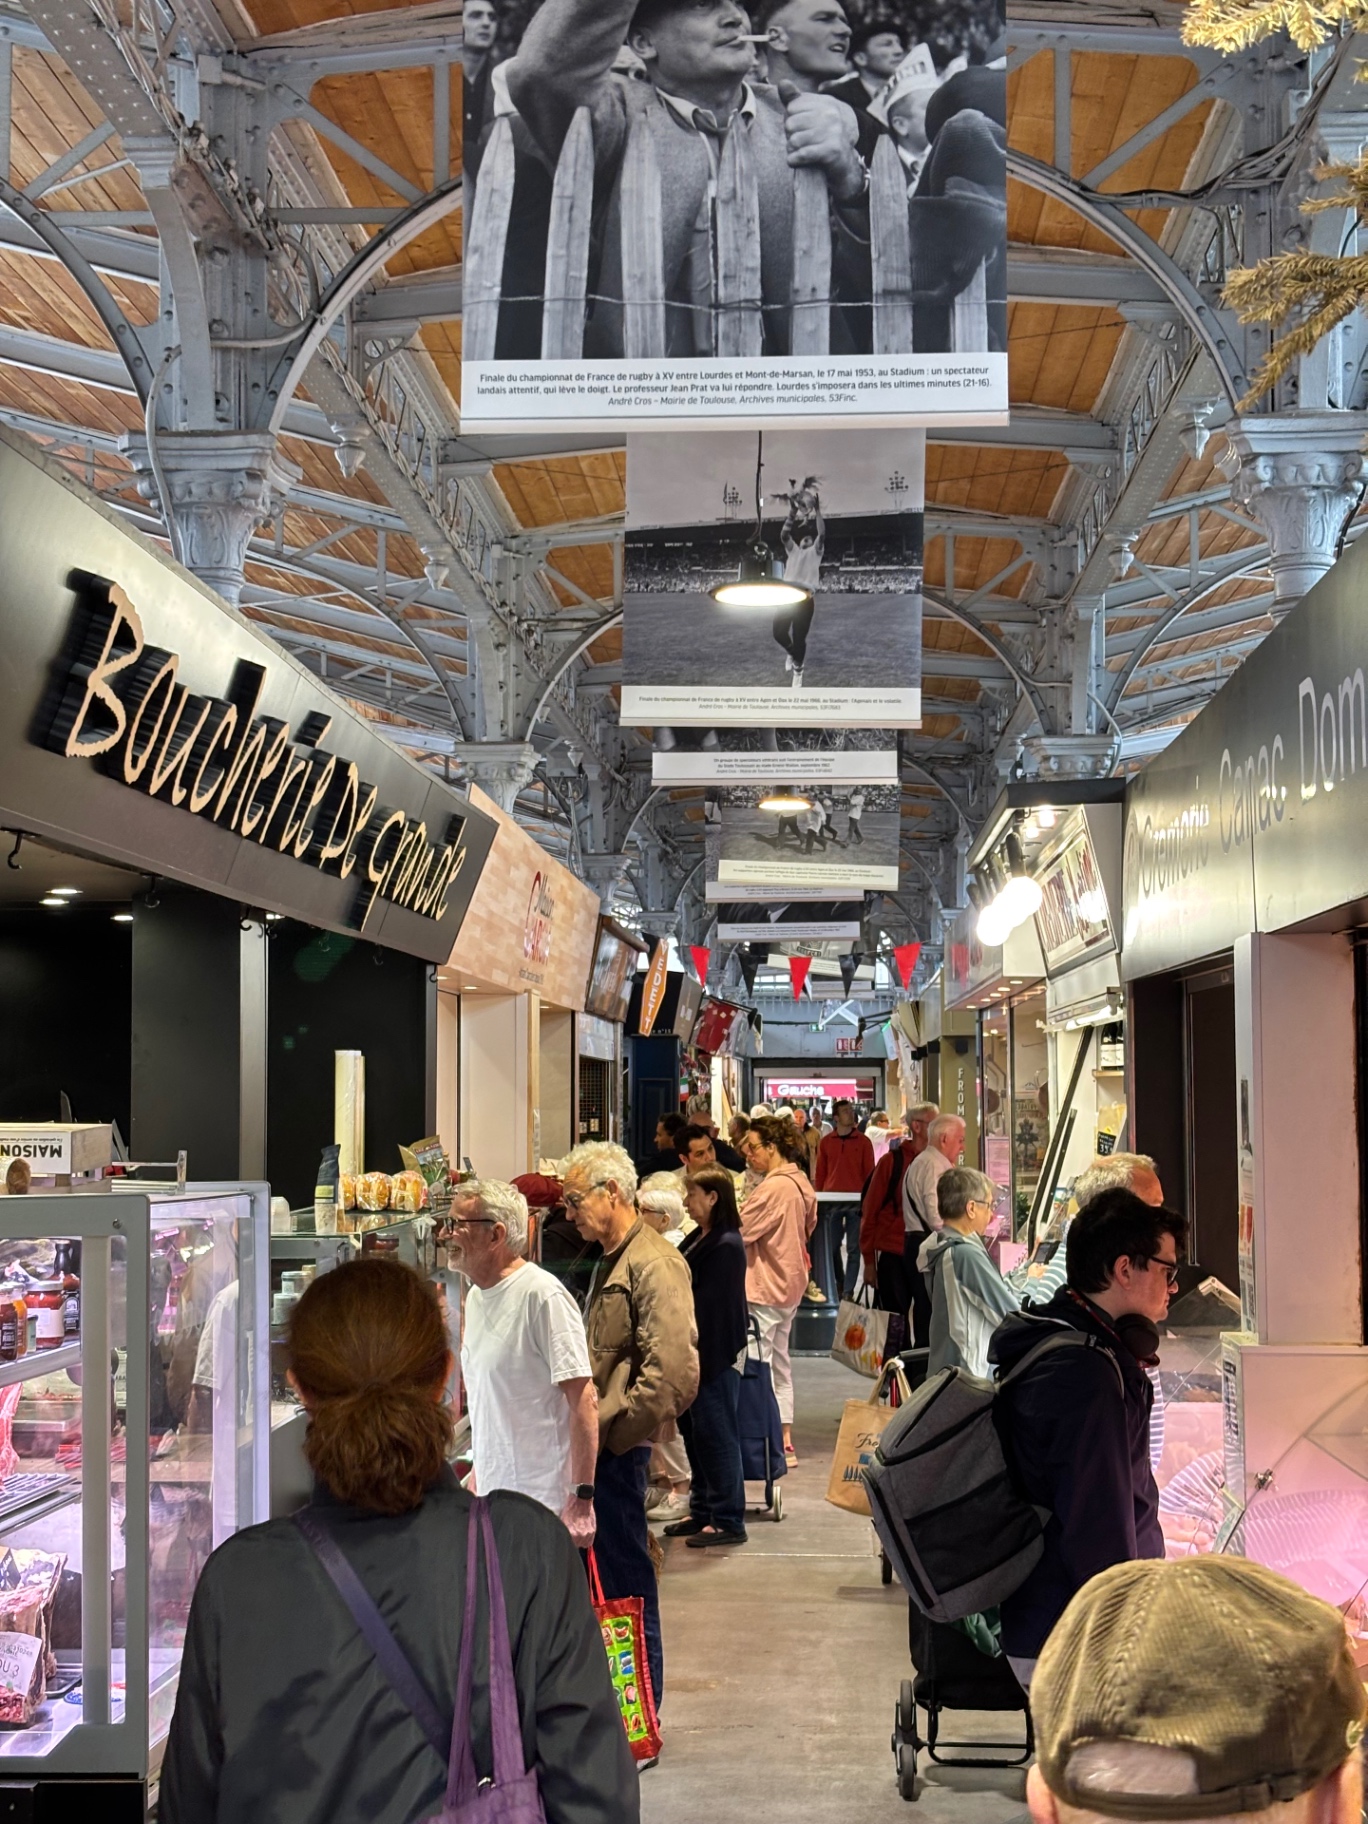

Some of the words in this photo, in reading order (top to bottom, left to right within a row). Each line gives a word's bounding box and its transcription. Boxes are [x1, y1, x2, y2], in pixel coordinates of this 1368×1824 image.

[479, 373, 505, 382] Finale
[506, 373, 517, 382] du
[518, 373, 572, 383] championnat
[574, 373, 585, 381] de
[586, 372, 615, 381] France
[616, 372, 627, 381] de
[628, 372, 653, 381] rugby
[654, 372, 660, 380] à
[662, 371, 674, 380] XV
[675, 372, 698, 380] entre
[699, 370, 733, 379] Lourdes
[734, 371, 743, 379] et
[745, 369, 815, 379] Mont-de-Marsan,
[817, 369, 825, 377] le
[826, 368, 835, 377] 17
[836, 368, 852, 377] mai
[854, 368, 876, 377] 1953,
[890, 367, 924, 376] Stadium
[944, 366, 988, 377] spectateur
[477, 386, 506, 394] landais
[508, 386, 541, 394] attentif,
[543, 386, 556, 395] qui
[558, 385, 576, 393] lève
[577, 385, 585, 393] le
[586, 385, 610, 394] doigt.
[612, 384, 622, 393] Le
[624, 384, 668, 394] professeur
[670, 384, 688, 392] Jean
[690, 383, 707, 392] Prat
[709, 384, 720, 392] va
[722, 383, 732, 391] lui
[734, 382, 773, 392] répondre.
[776, 381, 810, 391] Lourdes
[857, 381, 878, 389] dans
[879, 380, 892, 389] les
[893, 380, 925, 388] ultimes
[926, 379, 961, 388] minutes
[962, 378, 991, 387] (21-16).
[607, 396, 632, 405] André
[634, 396, 652, 405] Cros
[660, 396, 686, 405] Mairie
[687, 396, 697, 404] de
[700, 395, 736, 404] Toulouse,
[738, 394, 774, 403] Archives
[776, 394, 826, 403] municipales,
[63, 582, 337, 859] Boucherie
[1219, 733, 1285, 854] Canac
[777, 1084, 825, 1096] Gauche
[0, 1144, 62, 1158] MAISON
